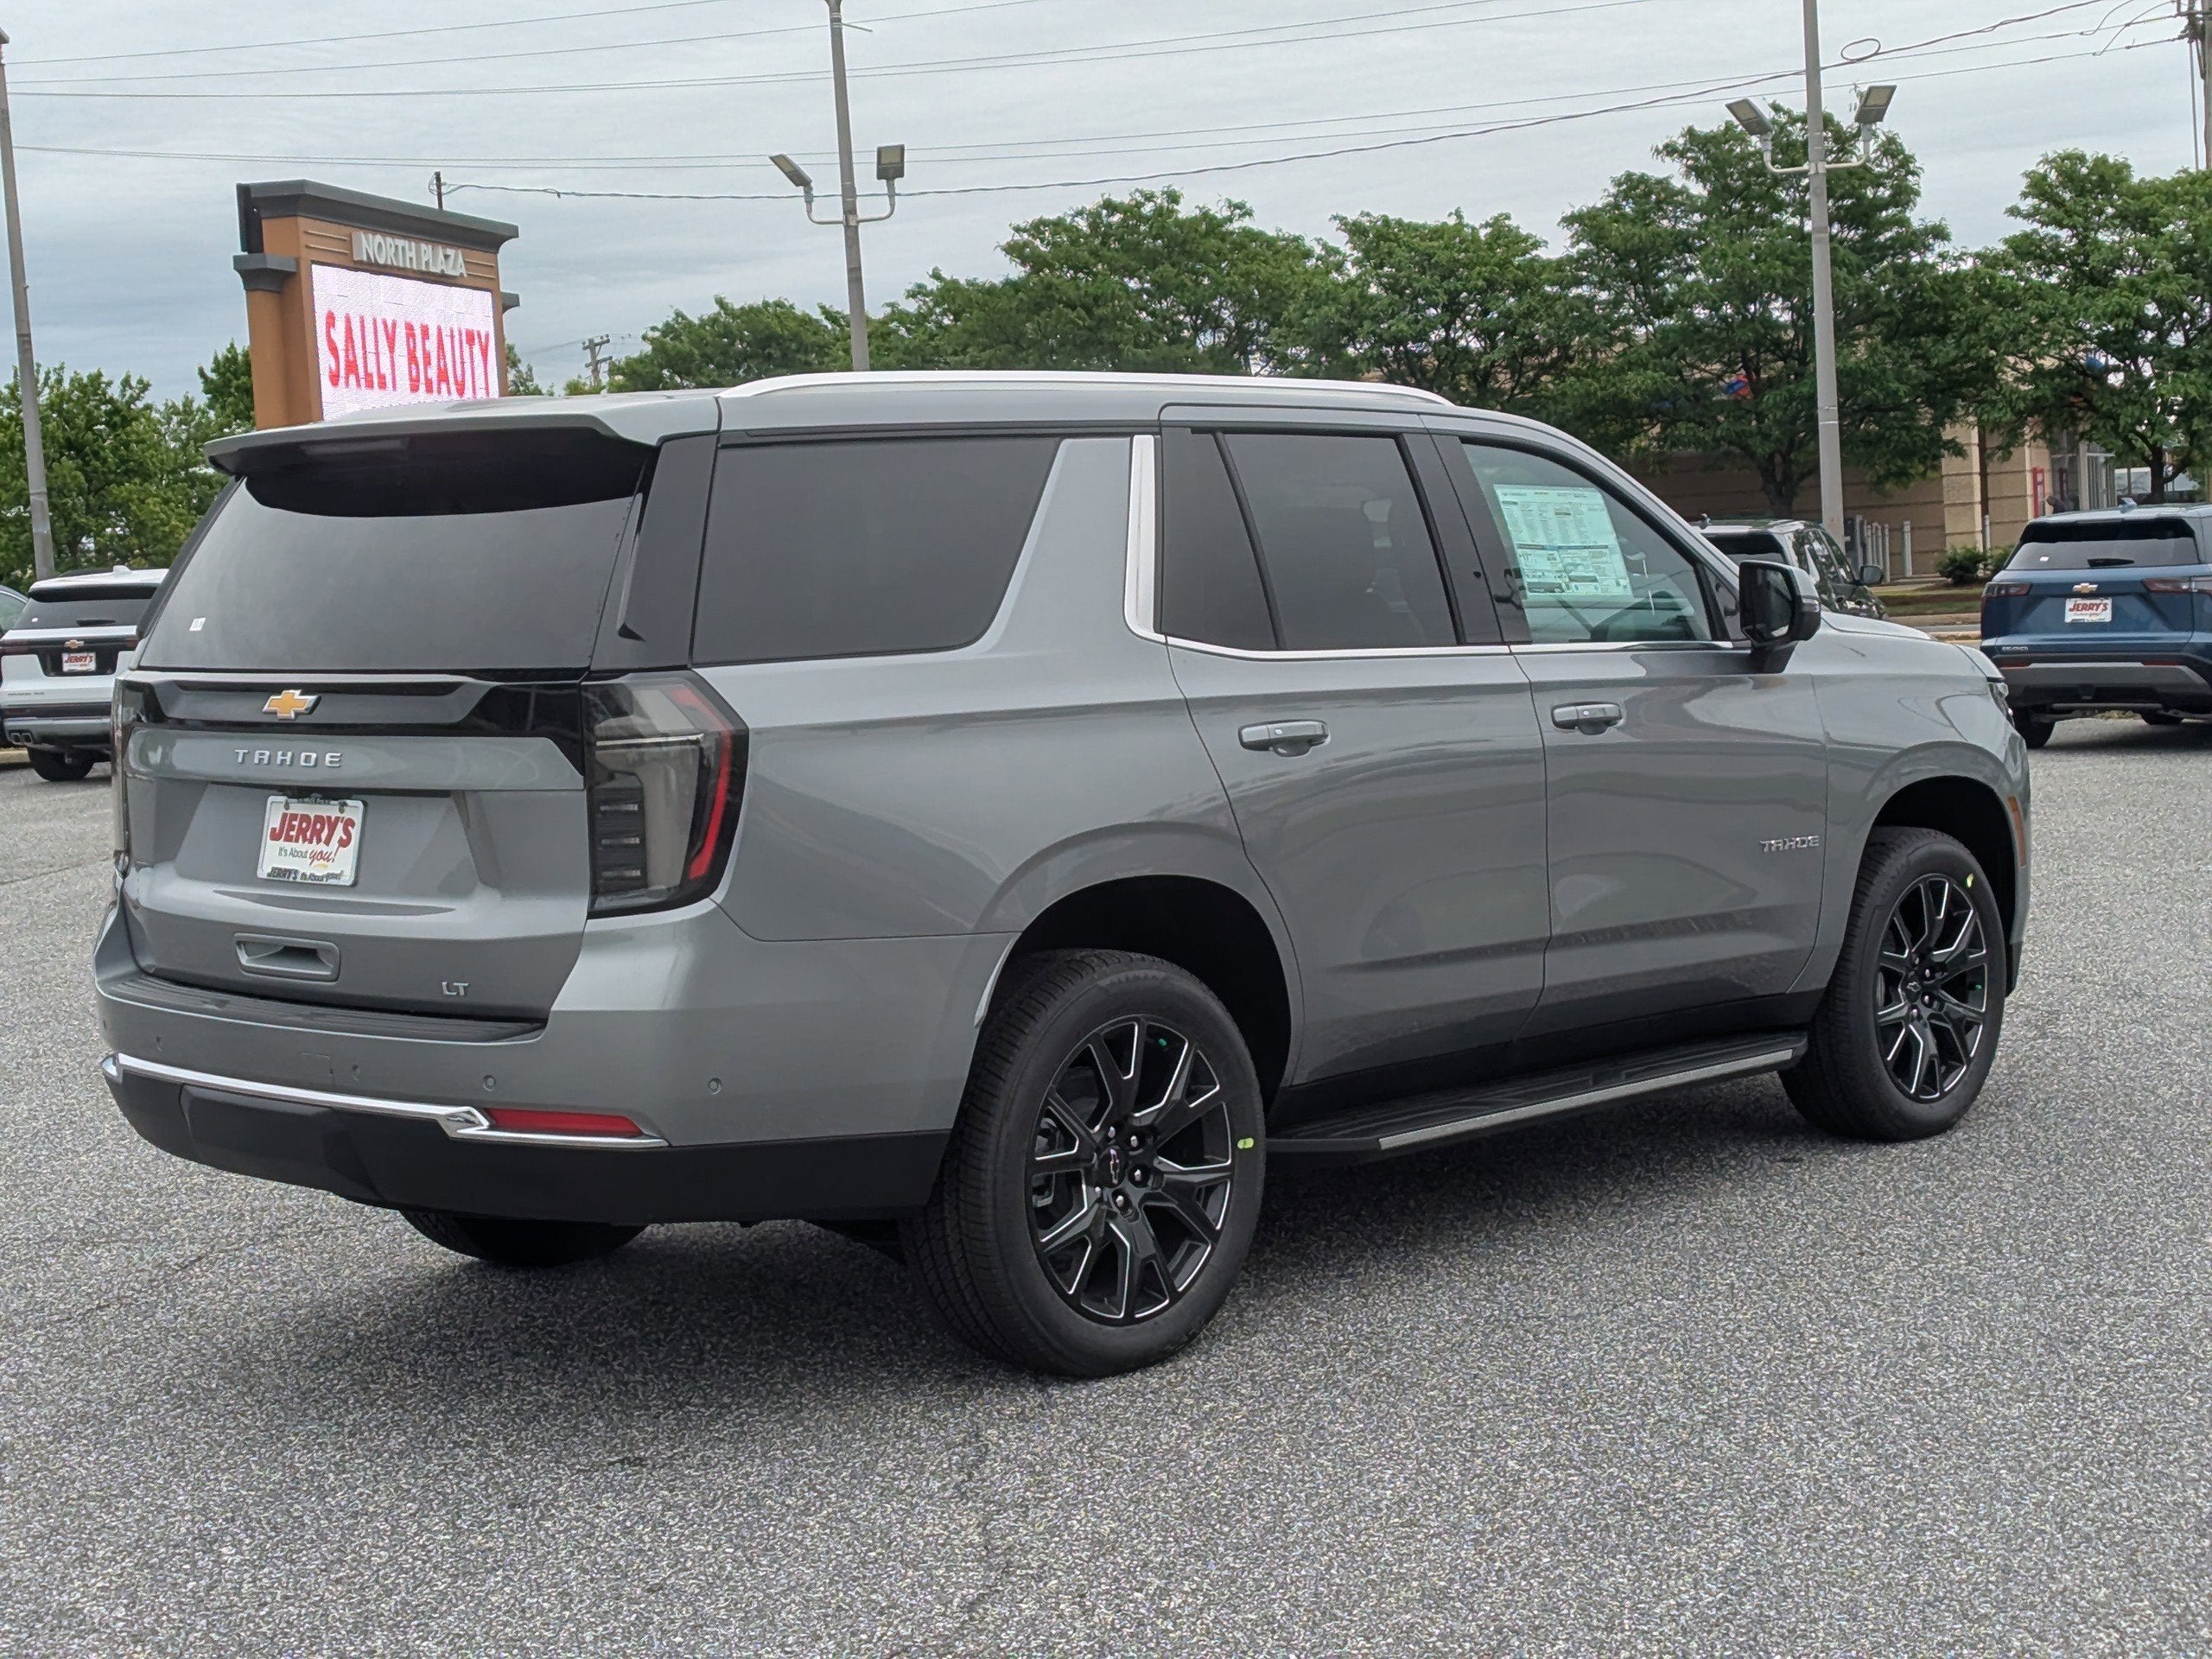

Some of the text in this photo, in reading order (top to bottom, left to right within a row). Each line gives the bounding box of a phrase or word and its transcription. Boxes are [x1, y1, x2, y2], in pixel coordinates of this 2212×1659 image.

[360, 231, 467, 277] NORTH PLAZA
[325, 309, 490, 399] SALLY BEAUTY
[2069, 602, 2108, 612] JERRY'S
[234, 749, 342, 767] TAHOE
[270, 812, 355, 848] JERRY'S
[1759, 835, 1820, 852] TAHOE
[278, 844, 340, 866] It's About you!
[442, 982, 469, 996] LT
